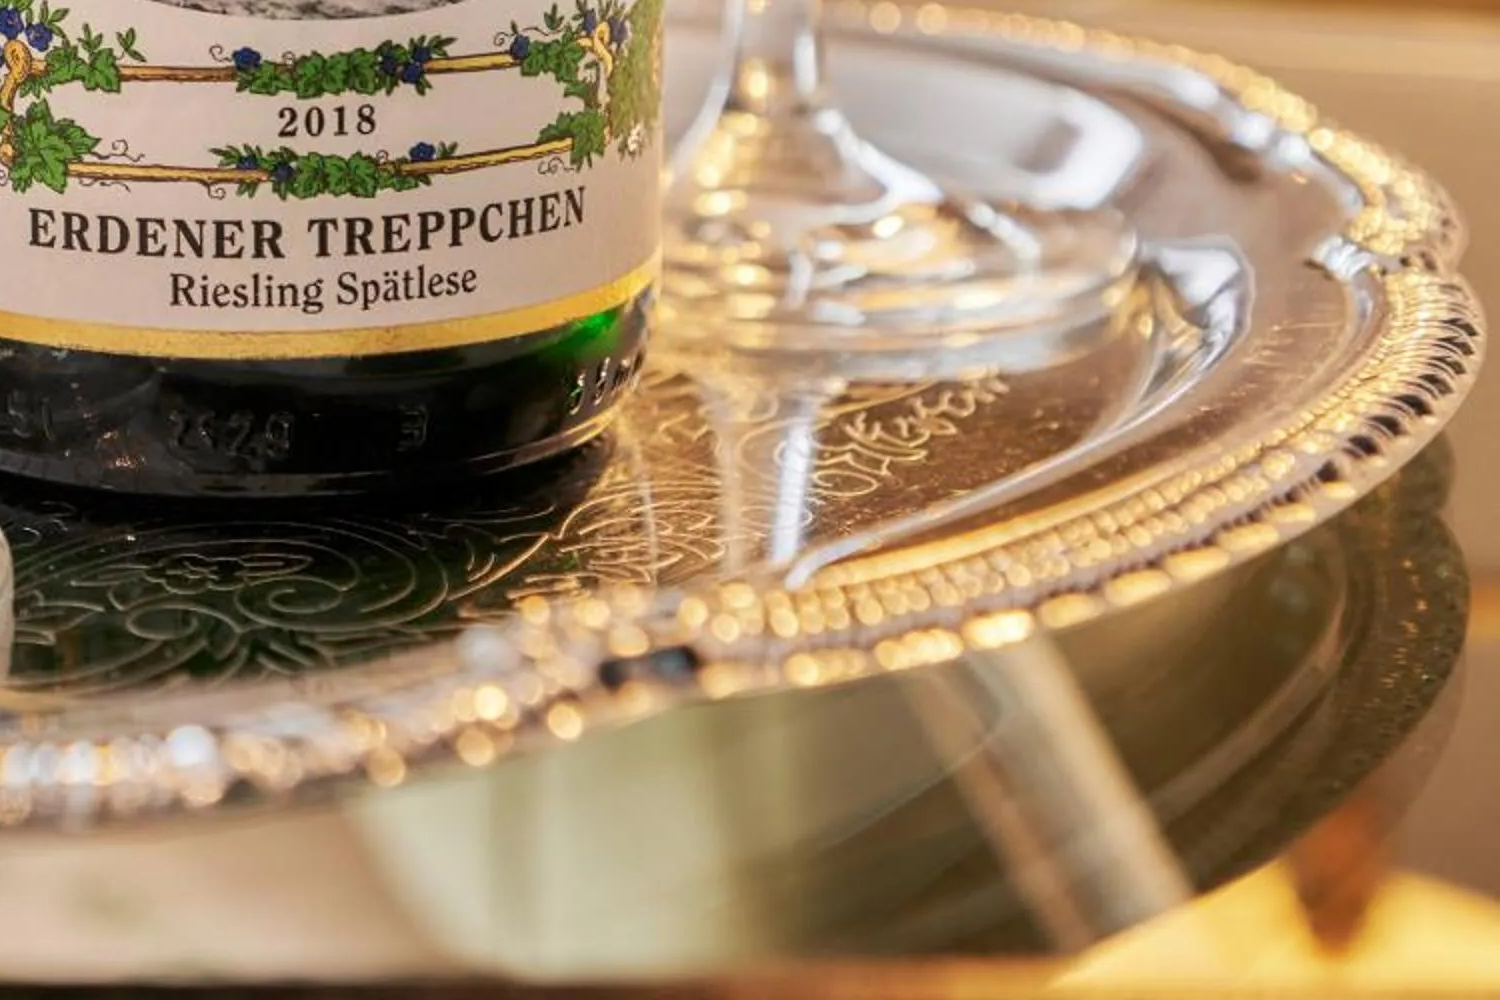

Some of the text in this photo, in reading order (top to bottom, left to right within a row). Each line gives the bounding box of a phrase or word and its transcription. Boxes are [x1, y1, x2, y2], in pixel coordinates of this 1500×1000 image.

[277, 103, 377, 138] 2018
[28, 184, 587, 260] ERDENER TREPPCHEN
[169, 264, 478, 315] Riesling Spätlese
